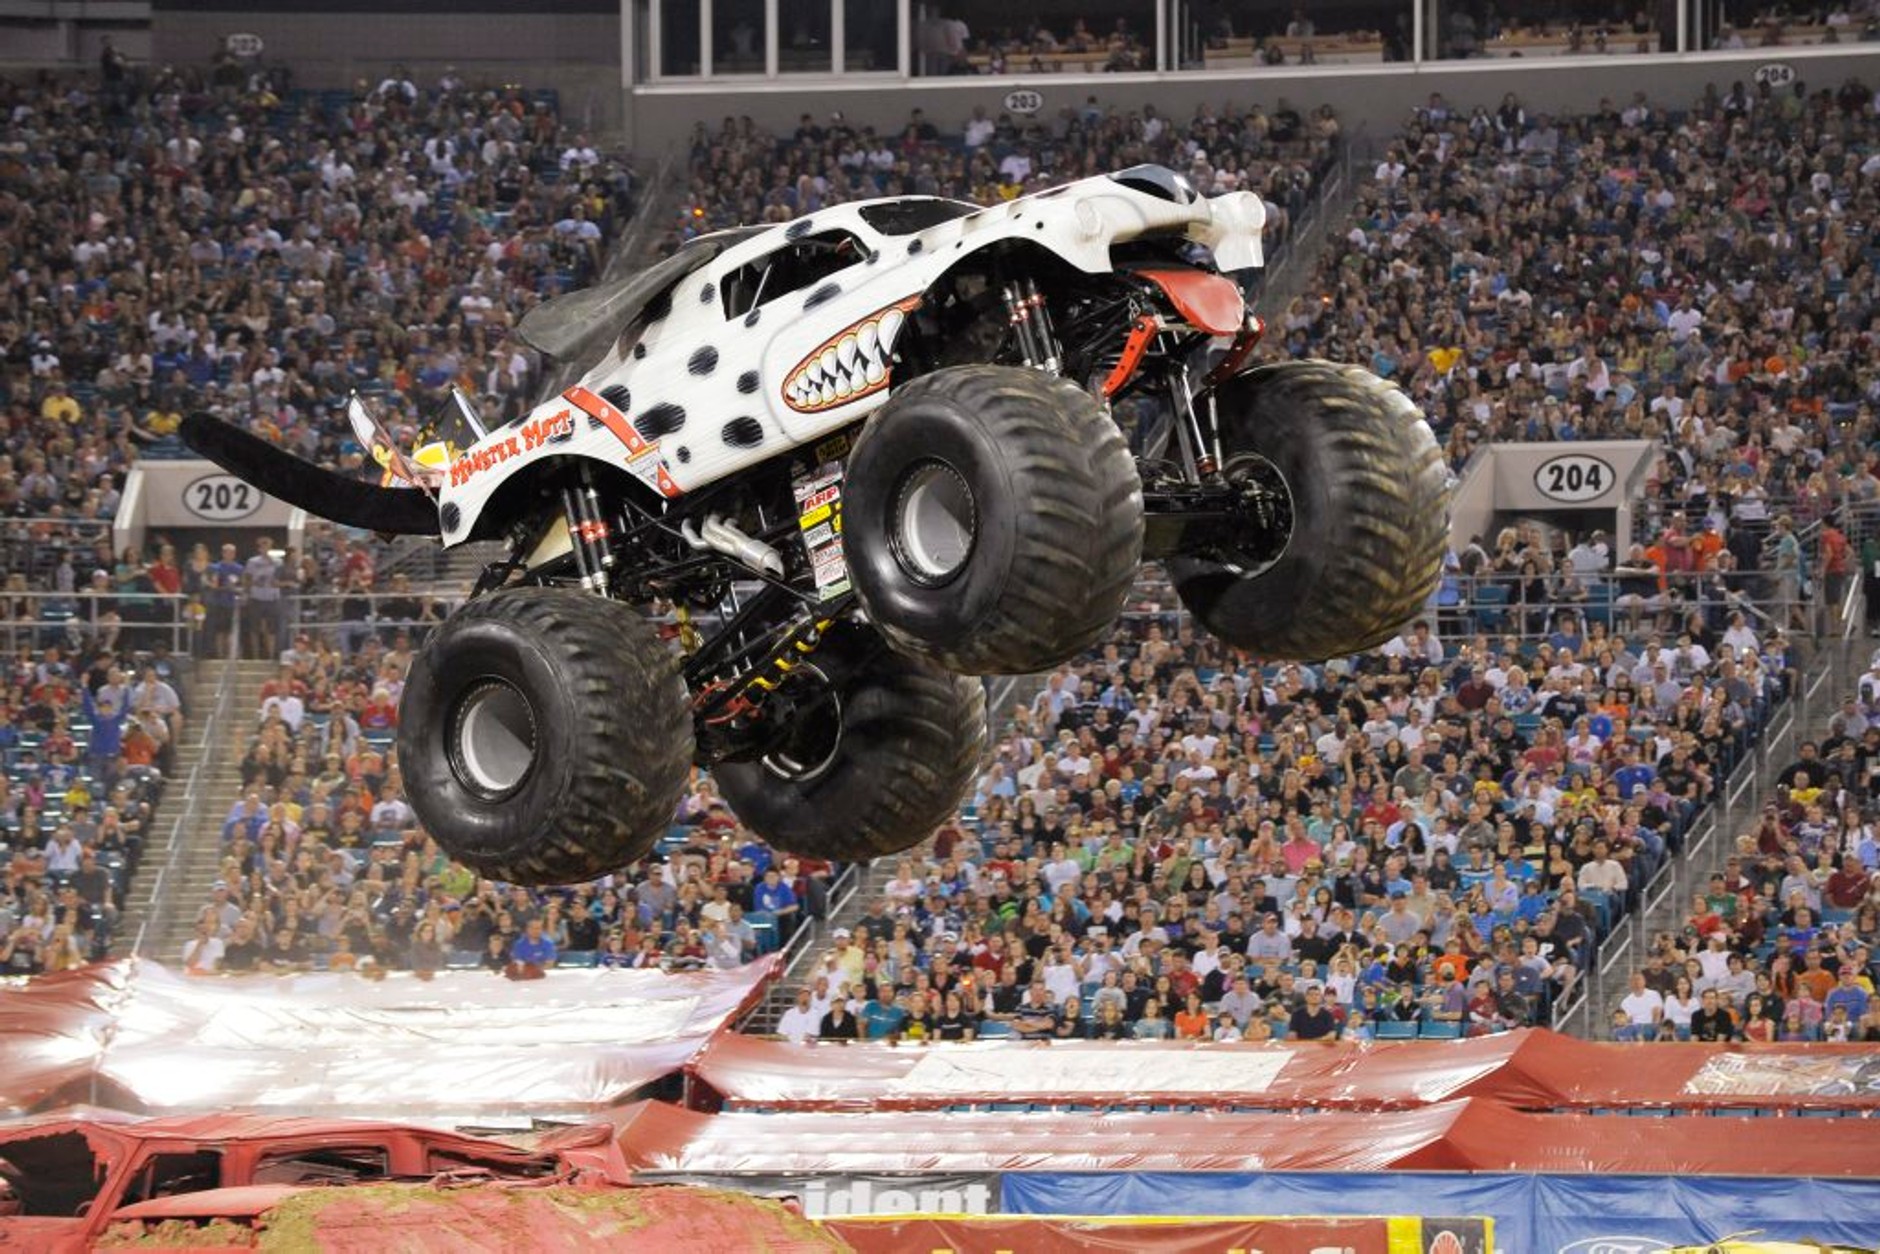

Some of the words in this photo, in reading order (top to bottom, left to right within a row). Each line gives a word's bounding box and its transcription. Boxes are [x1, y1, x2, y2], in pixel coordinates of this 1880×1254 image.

[1760, 67, 1789, 82] 204
[1010, 94, 1037, 109] 203
[1548, 464, 1602, 492] 204
[196, 483, 249, 510] 202
